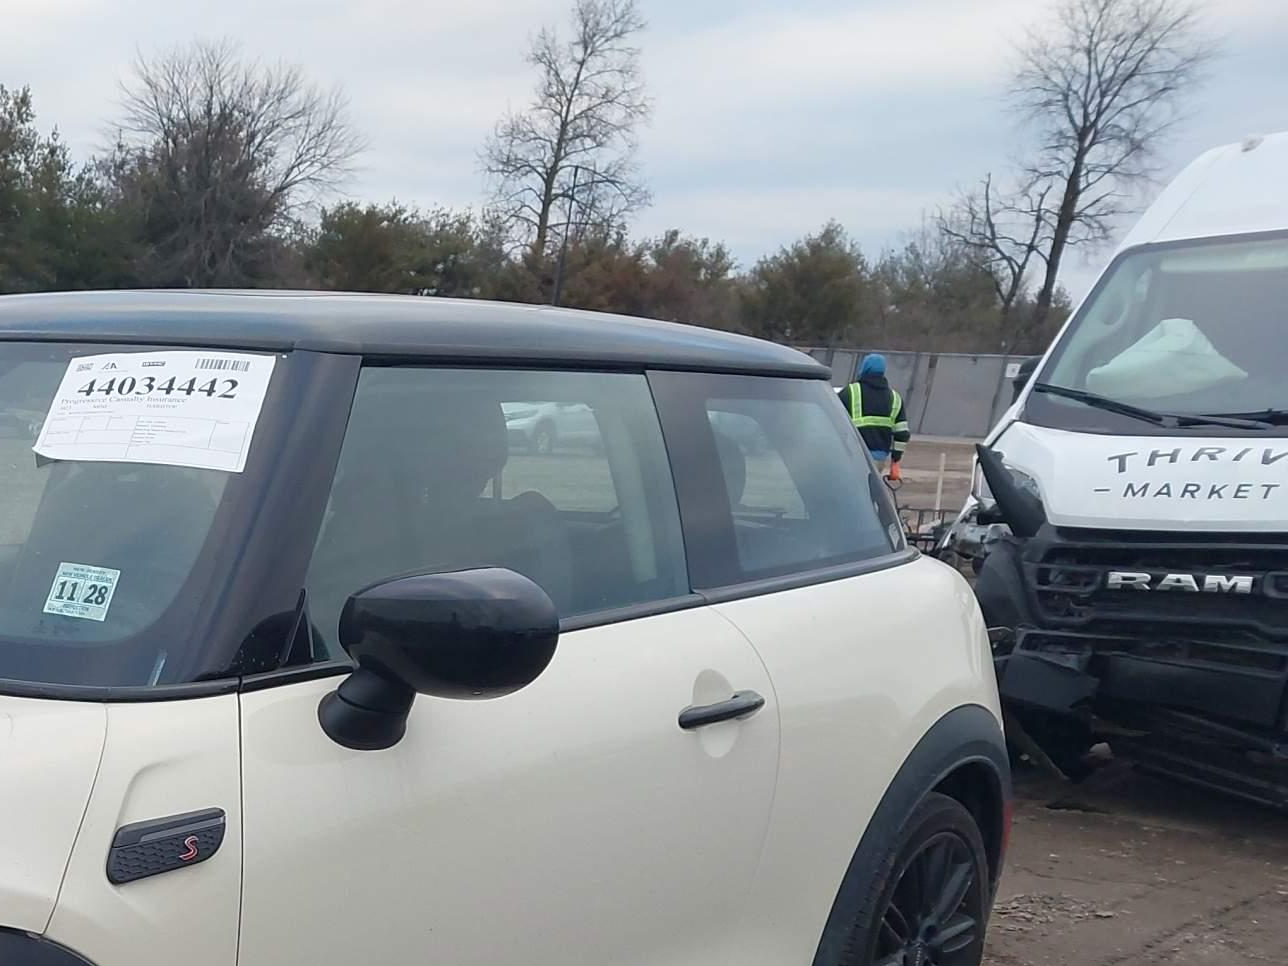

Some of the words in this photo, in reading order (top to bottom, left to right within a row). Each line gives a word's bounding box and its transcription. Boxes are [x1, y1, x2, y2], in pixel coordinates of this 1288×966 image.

[77, 375, 239, 399] 44034442
[1123, 482, 1280, 500] MARKET
[55, 580, 79, 601] 11
[83, 583, 108, 605] 28
[1108, 571, 1254, 594] RAM
[178, 834, 199, 861] S
